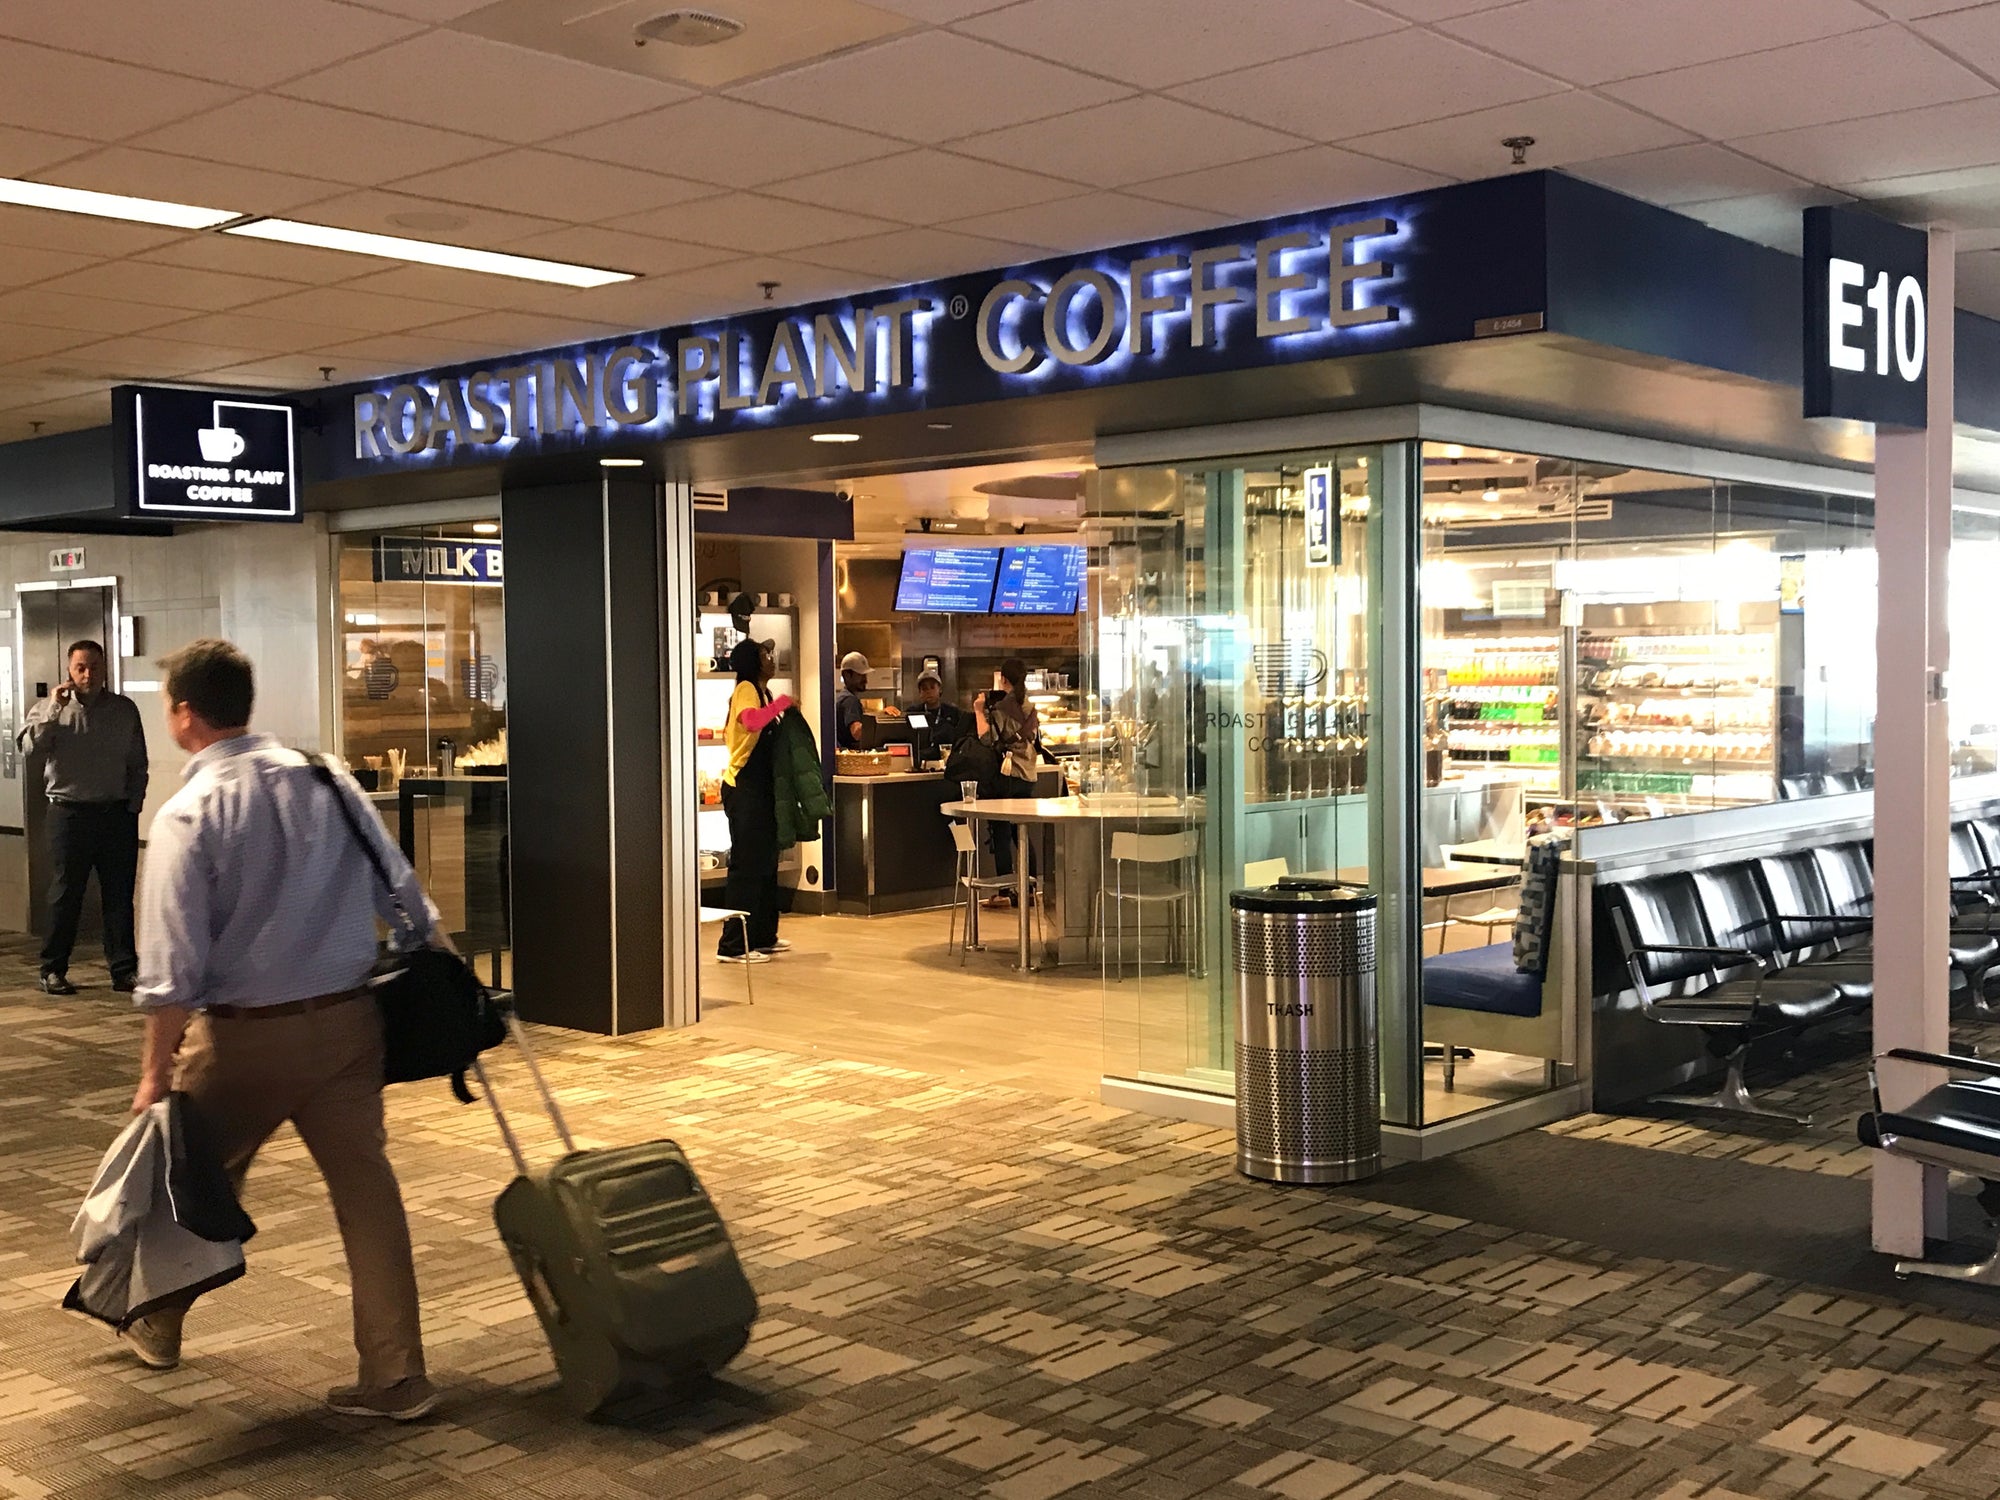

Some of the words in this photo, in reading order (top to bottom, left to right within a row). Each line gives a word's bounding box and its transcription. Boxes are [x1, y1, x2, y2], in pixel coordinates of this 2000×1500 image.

[1829, 257, 1925, 382] E10
[354, 346, 657, 459] ROASTING
[678, 298, 932, 415] PLANT
[976, 217, 1399, 374] COFFEE
[148, 463, 230, 482] ROASTING
[234, 469, 285, 485] PLANT
[186, 485, 253, 503] COFFEE
[402, 546, 479, 577] MILK
[1267, 1003, 1314, 1017] TRASH
